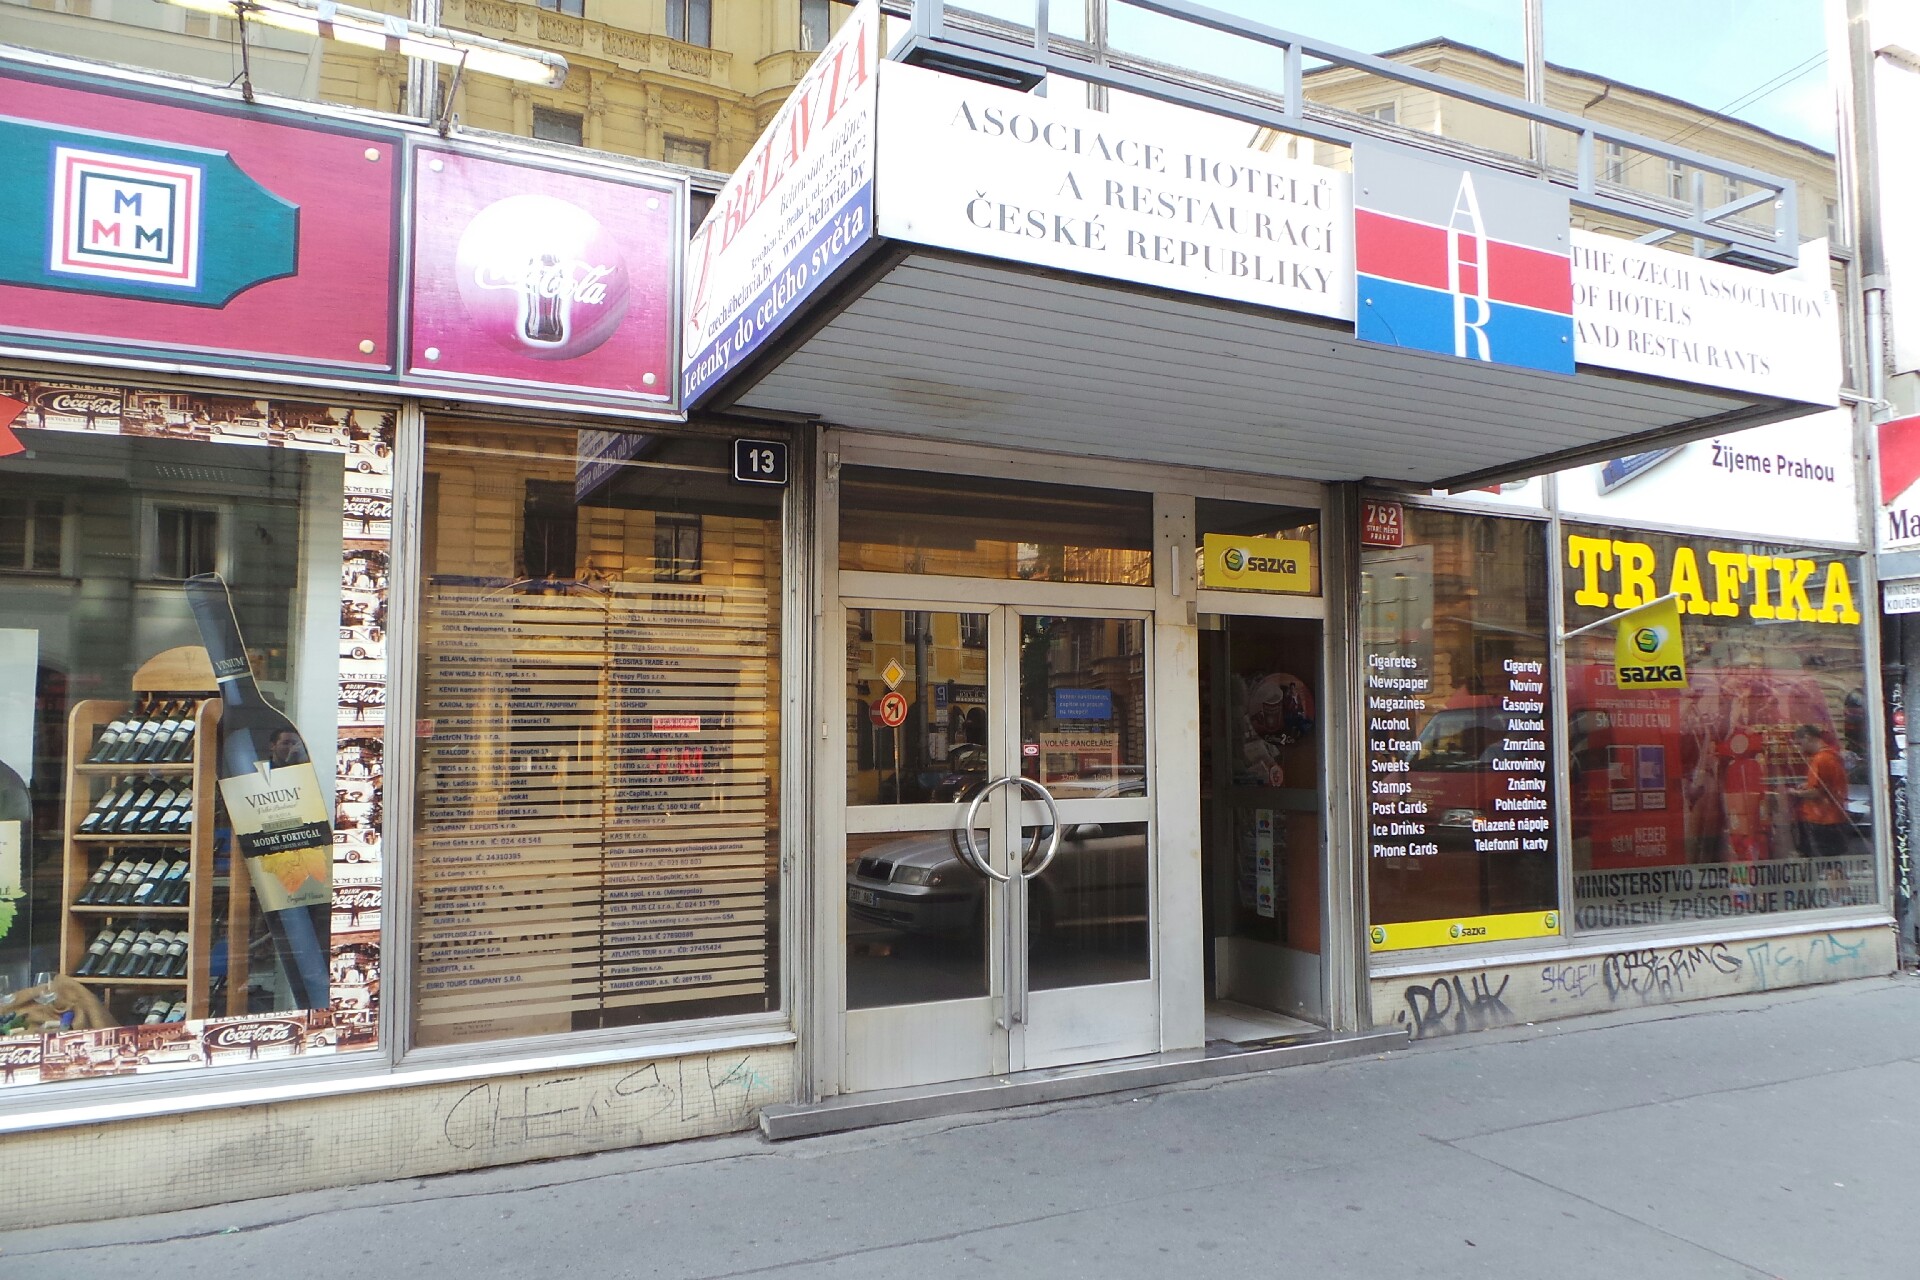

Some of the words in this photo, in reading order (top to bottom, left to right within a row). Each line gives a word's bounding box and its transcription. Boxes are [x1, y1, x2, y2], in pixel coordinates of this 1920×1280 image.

[719, 22, 869, 256] BELAVIA
[951, 100, 1166, 174] ASOCIACE
[1184, 154, 1333, 212] HOTELŮ
[114, 189, 141, 216] M
[783, 160, 866, 257] www.belavia.by
[1057, 170, 1083, 200] A
[1105, 178, 1333, 254] RESTAURACÍ
[93, 220, 120, 247] M
[135, 227, 163, 253] M
[965, 189, 1106, 252] ČESKÉ
[1126, 229, 1334, 295] REPUBLIKY
[1571, 245, 1616, 277] THE
[1621, 257, 1692, 291] CZECH
[1699, 271, 1826, 321] ASSOCIATION
[684, 337, 732, 399] Letenky
[734, 319, 753, 351] do
[756, 263, 808, 331] celého
[811, 206, 864, 276] světa
[1571, 282, 1601, 308] OF
[1608, 287, 1693, 328] HOTELS
[1573, 321, 1620, 351] AND
[1627, 328, 1771, 377] RESTAURANTS
[749, 449, 775, 474] 13
[1711, 440, 1772, 475] Žijeme
[1777, 458, 1835, 483] Prahou
[1368, 505, 1397, 525] 762
[1248, 555, 1296, 574] sazka
[1568, 535, 1861, 625] TRAFIKA
[1369, 654, 1417, 669] Cigaretes
[1504, 660, 1542, 674] Cigarety
[1619, 665, 1683, 684] sazka
[1369, 676, 1428, 691] Newspaper
[1510, 680, 1543, 694] Noviny
[1370, 697, 1425, 712] Magazines
[1503, 696, 1544, 713] Časopisy
[1370, 717, 1410, 731] Alcohol
[1508, 719, 1545, 731] Alkohol
[1045, 738, 1068, 747] VOLNÉ
[1071, 738, 1113, 747] KANCELÁŘE
[1371, 739, 1386, 751] Ice
[1388, 739, 1422, 751] Cream
[1503, 739, 1545, 751] Zmrzlina
[1372, 760, 1410, 772] Sweets
[1493, 758, 1546, 772] Cukrovinky
[1372, 781, 1412, 795] Stamps
[1508, 779, 1546, 792] Známky
[245, 787, 300, 808] VINIUM
[1495, 798, 1547, 811] Pohlednice
[1372, 802, 1395, 815] Post
[1398, 801, 1427, 814] Cards
[1373, 824, 1388, 836] Ice
[1390, 822, 1425, 836] Drinks
[1472, 818, 1515, 833] Chlazené
[1517, 818, 1549, 831] nápoje
[253, 835, 281, 847] MODRÝ
[281, 829, 321, 843] PORTUGAL
[1475, 838, 1519, 851] Telefonní
[1522, 838, 1548, 852] karty
[1373, 845, 1407, 858] Phone
[1409, 842, 1438, 856] Cards
[1573, 869, 1692, 899] MINISTERSTVO
[1698, 861, 1813, 890] ZDRAVOTNICTVÍ
[1575, 897, 1663, 931] KOUŘENÍ
[1670, 889, 1778, 922] ZPŮSOBUJE
[1461, 926, 1486, 936] sazka
